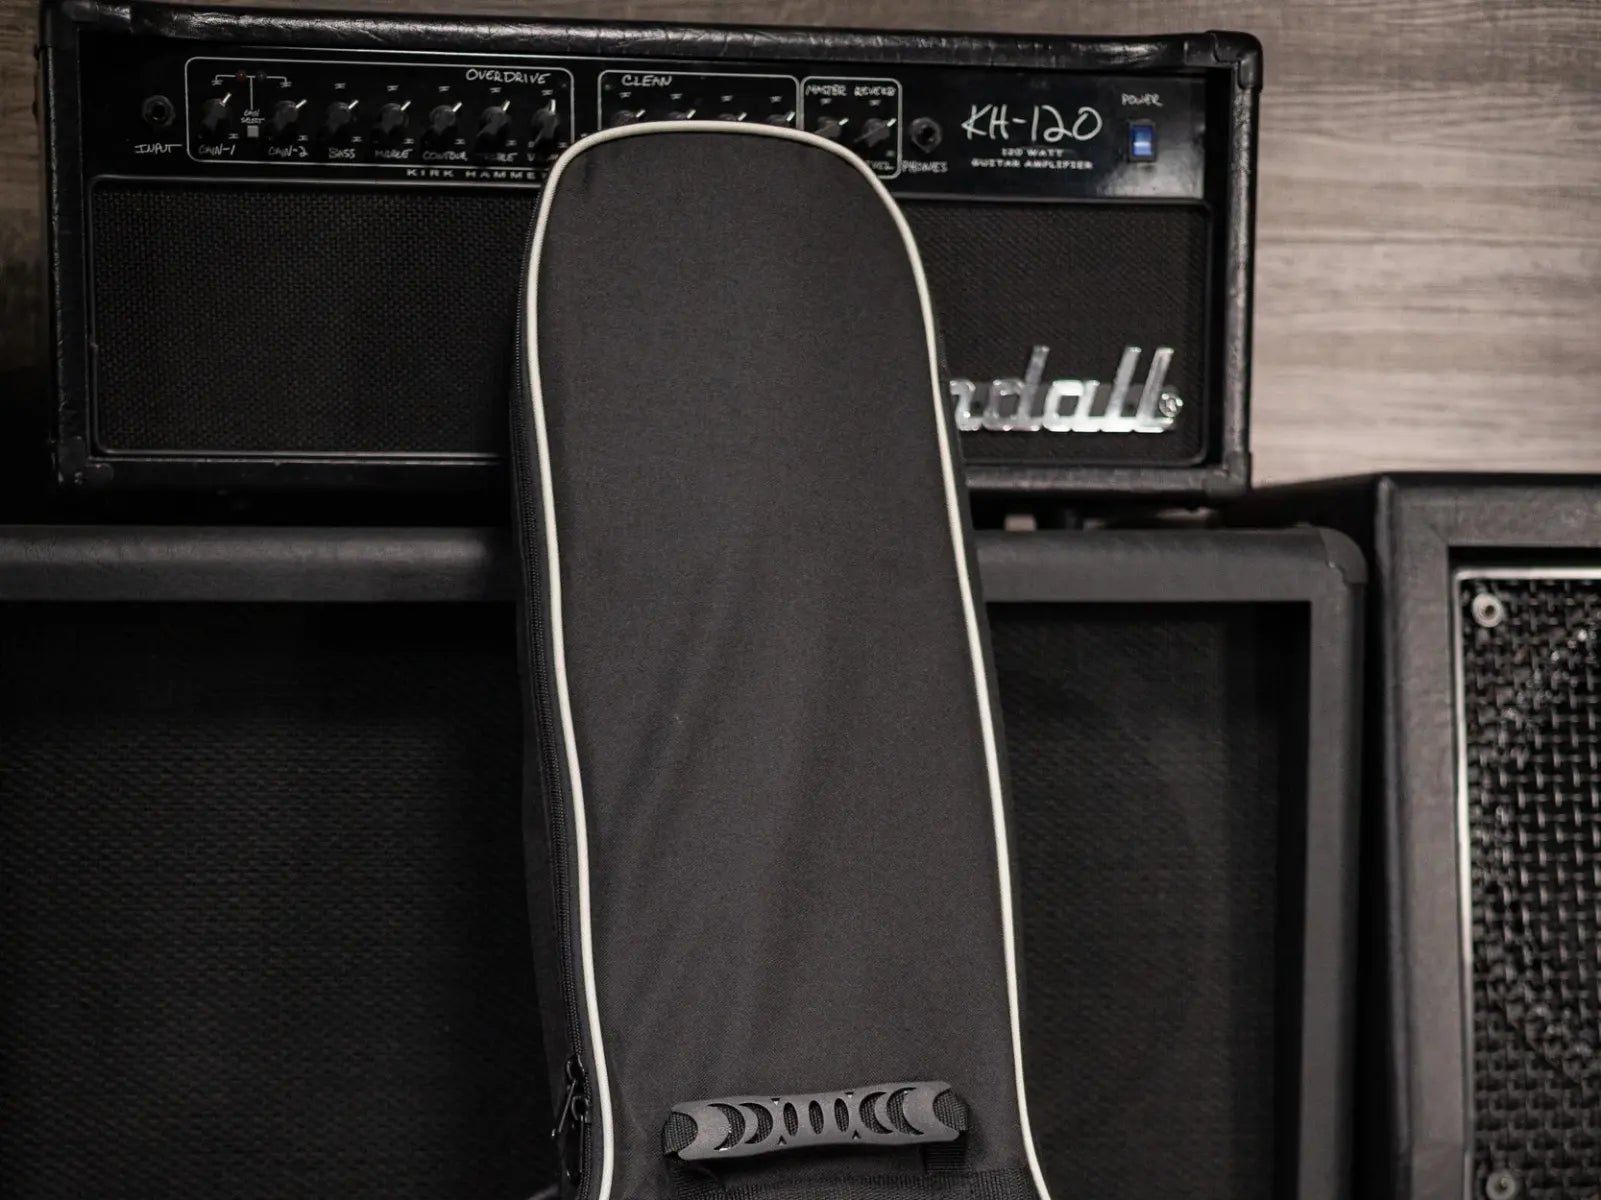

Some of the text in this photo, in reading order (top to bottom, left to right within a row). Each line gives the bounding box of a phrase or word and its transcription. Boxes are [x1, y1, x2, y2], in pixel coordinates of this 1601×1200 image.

[466, 68, 551, 85] OVERDRIVE
[621, 74, 673, 87] CLEAN
[805, 84, 848, 96] MASTER
[854, 86, 896, 97] REVERB
[1121, 93, 1164, 107] POWER
[961, 104, 1103, 142] KH-120
[134, 144, 184, 155] INPUT
[328, 147, 356, 159] BASS
[1027, 148, 1065, 158] WATT
[971, 157, 1094, 170] GUITAR AMPLIFIER
[407, 169, 549, 181] KIRK HAMME
[950, 345, 1176, 433] ndall
